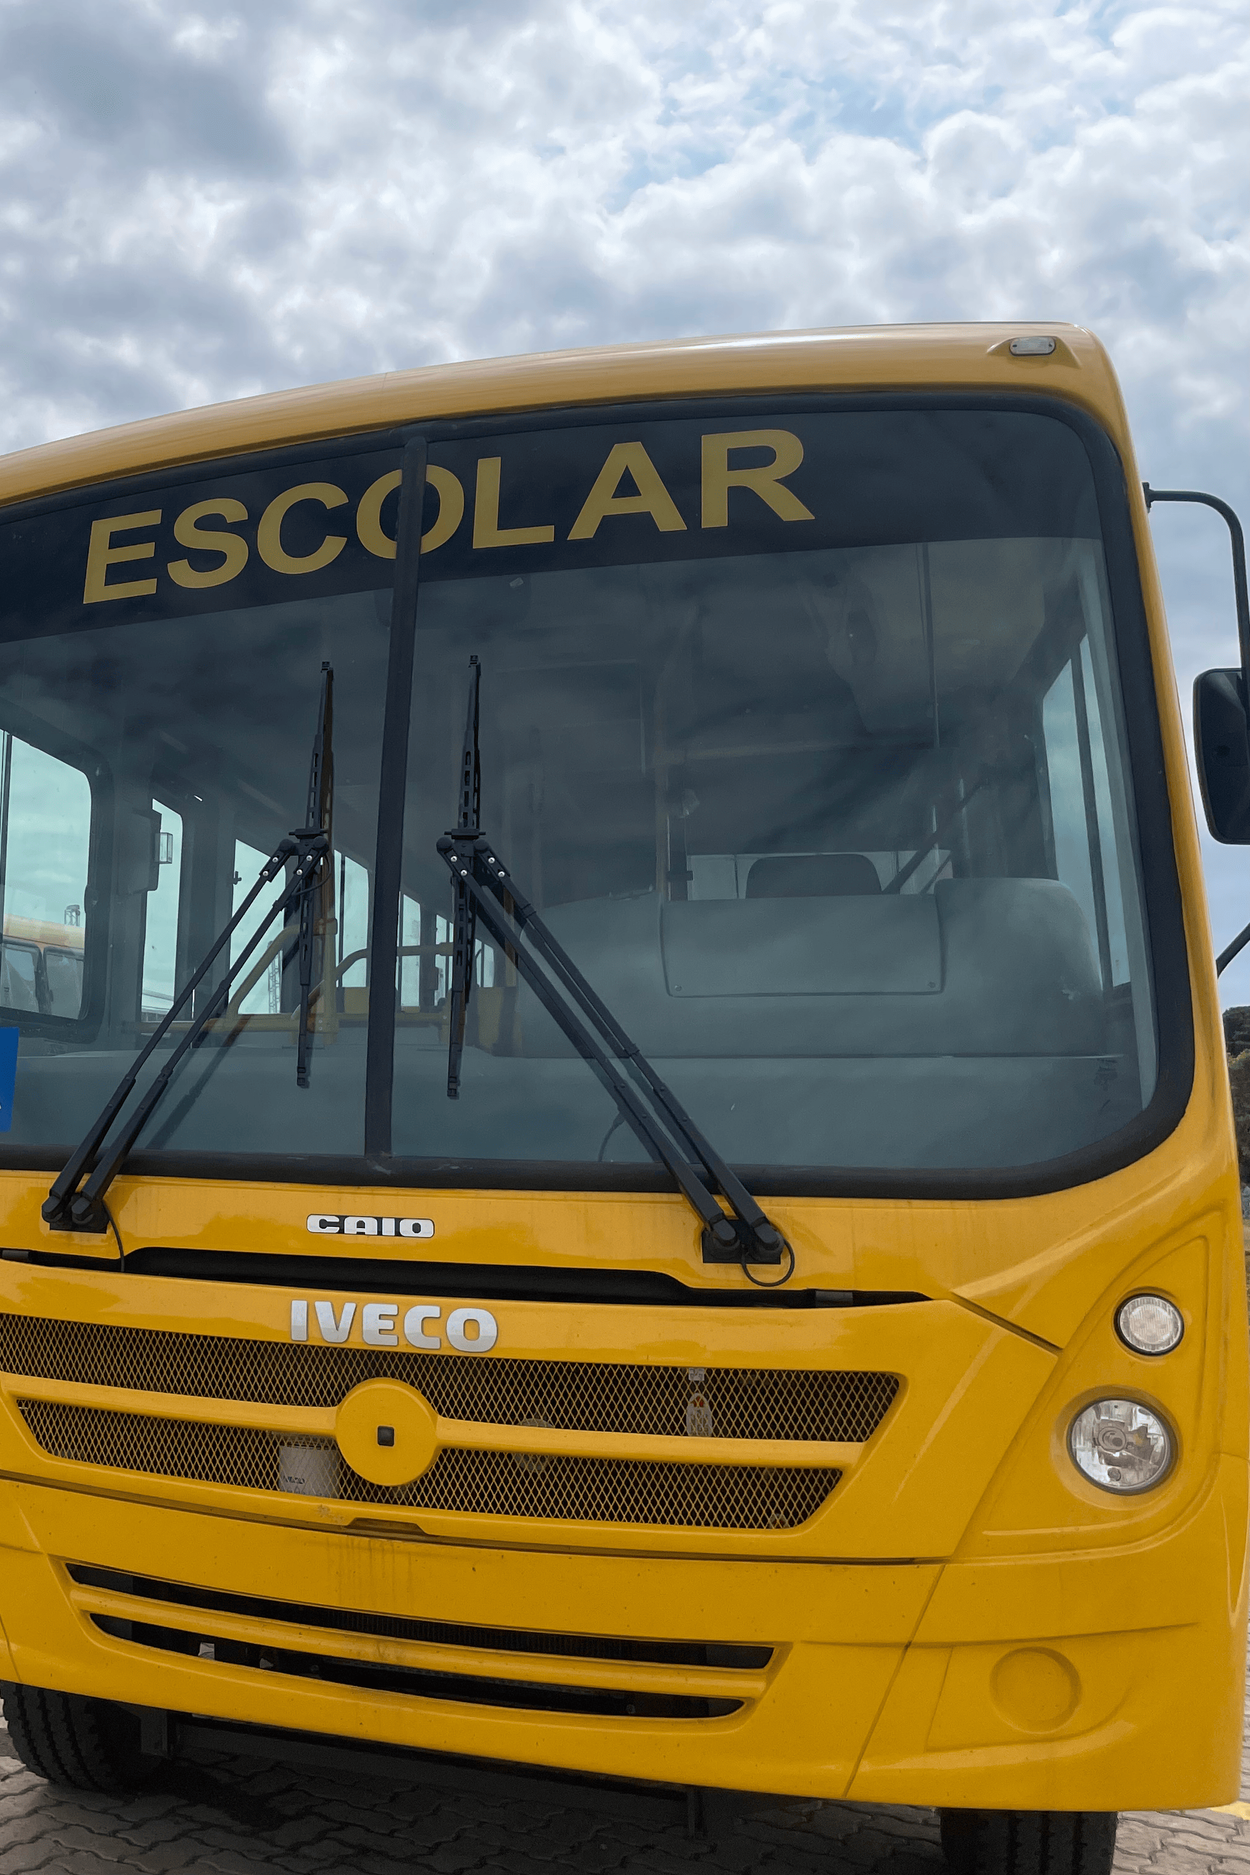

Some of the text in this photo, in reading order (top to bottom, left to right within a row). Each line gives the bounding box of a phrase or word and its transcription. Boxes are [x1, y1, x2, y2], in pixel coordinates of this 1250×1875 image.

[82, 428, 816, 605] ESCOLAR
[306, 1213, 435, 1239] CAIO
[290, 1299, 499, 1353] IVECO
